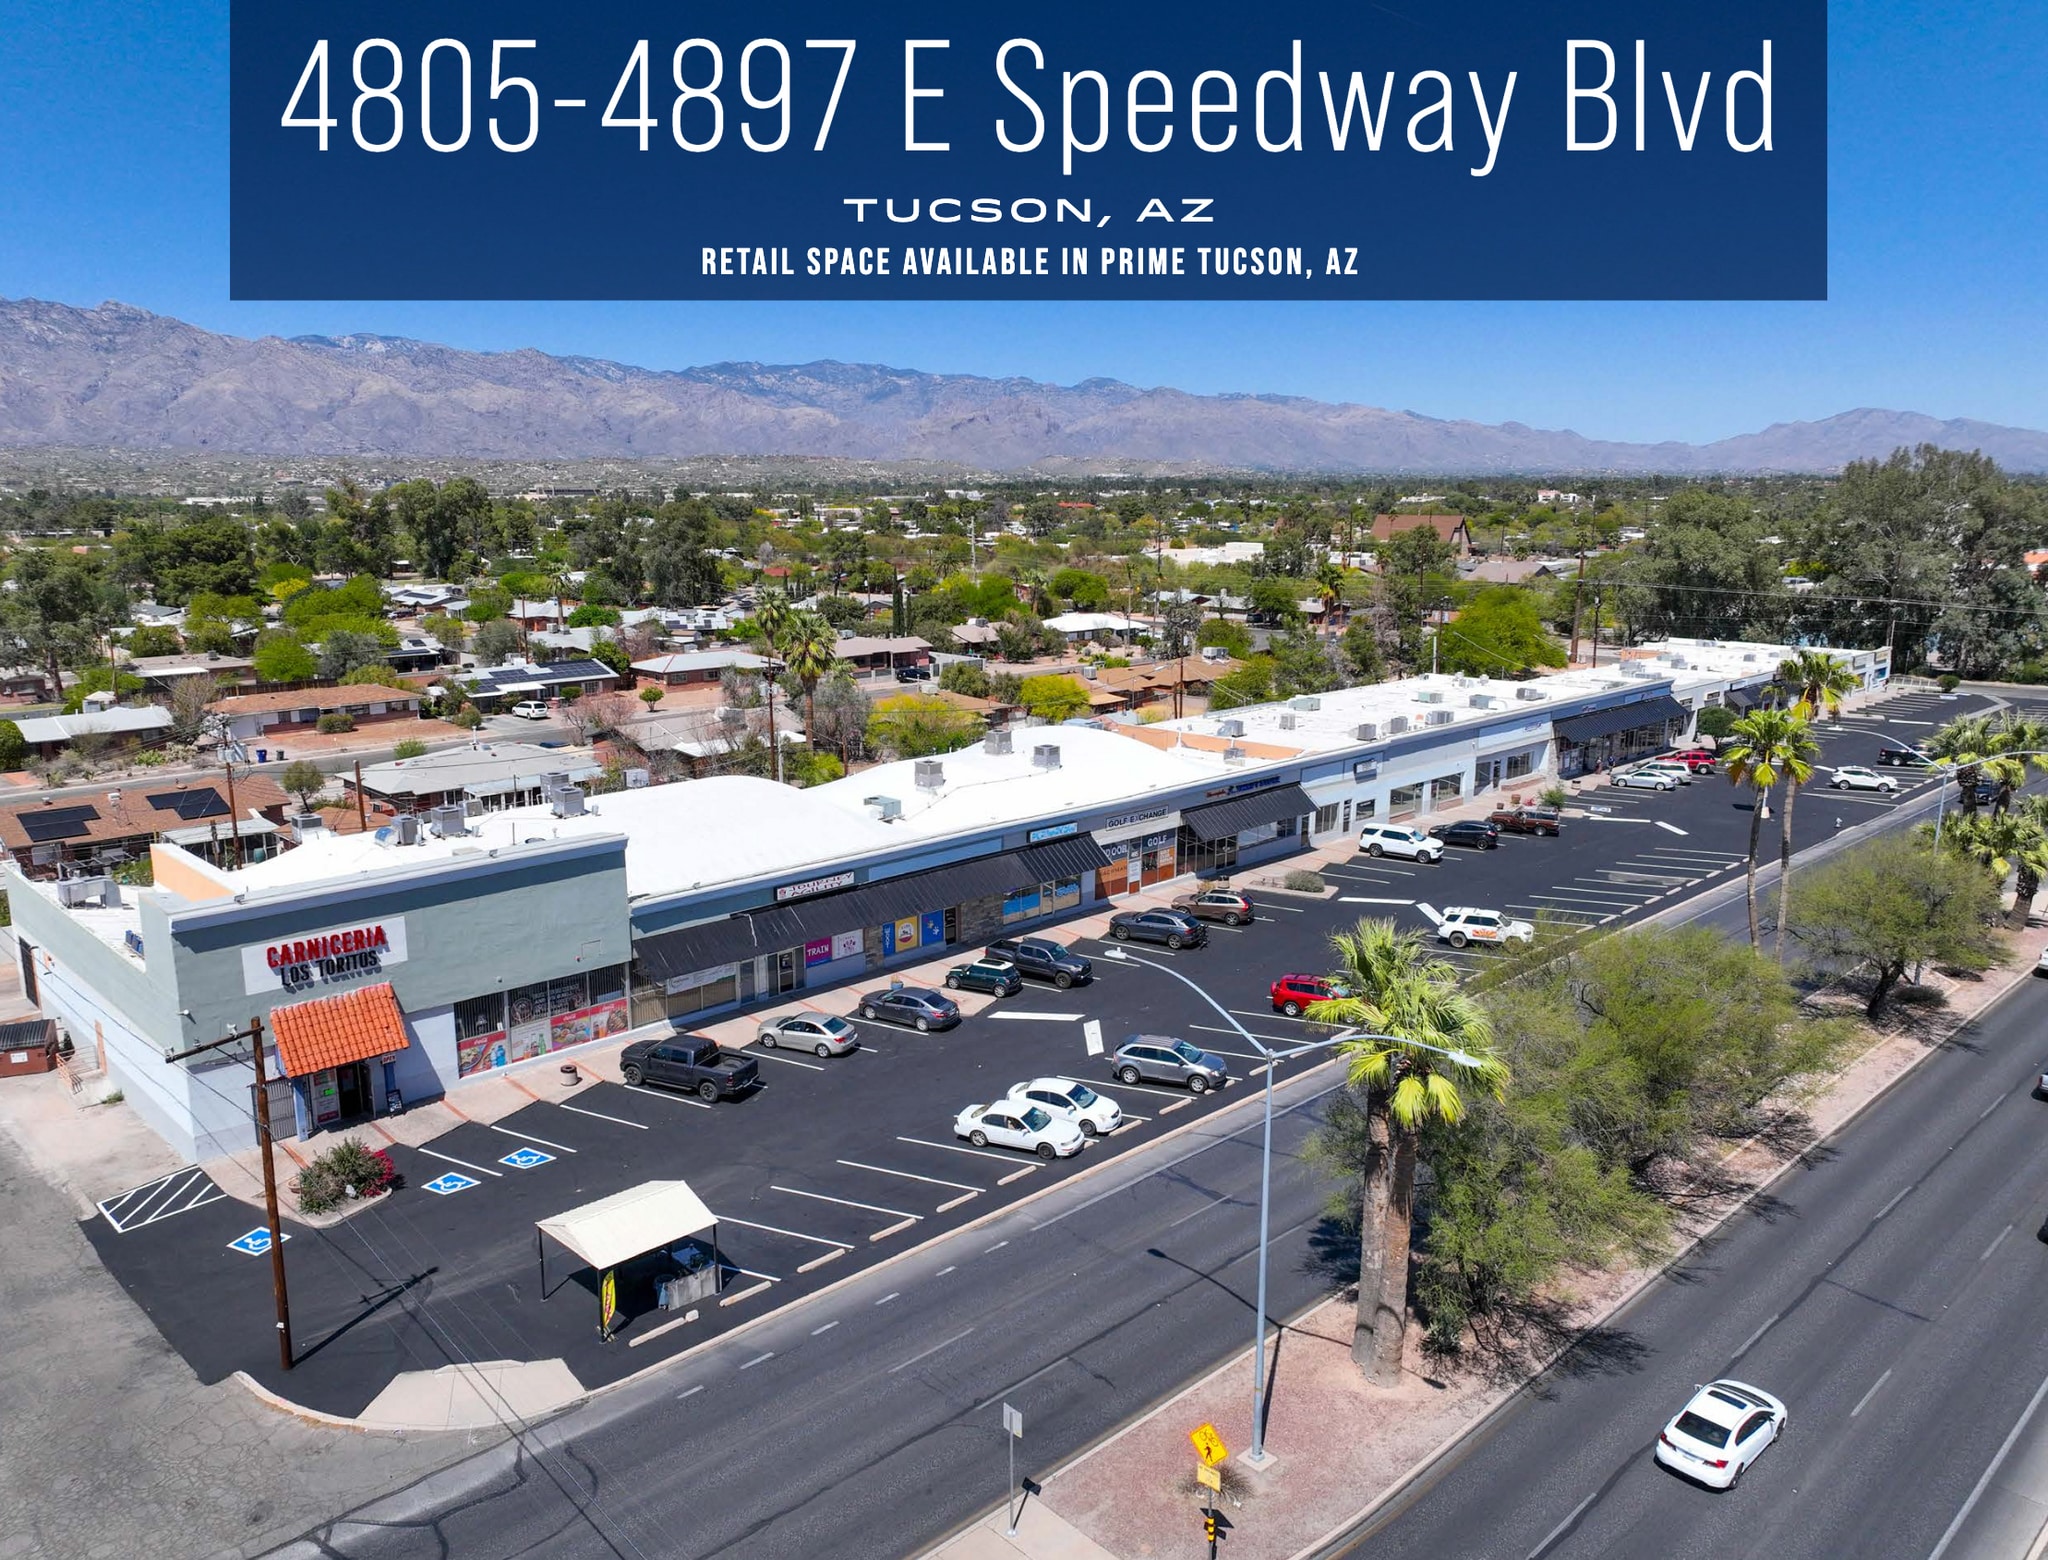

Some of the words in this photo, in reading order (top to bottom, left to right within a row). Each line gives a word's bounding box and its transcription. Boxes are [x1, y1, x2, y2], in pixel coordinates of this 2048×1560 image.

[1108, 817, 1128, 828] GOLF
[1147, 834, 1168, 847] GOLF
[789, 872, 852, 891] JOURNEY
[266, 925, 387, 968] CARNICERIA
[806, 944, 829, 957] TRAIN
[280, 964, 310, 987] LOS
[315, 949, 378, 977] TORITOS
